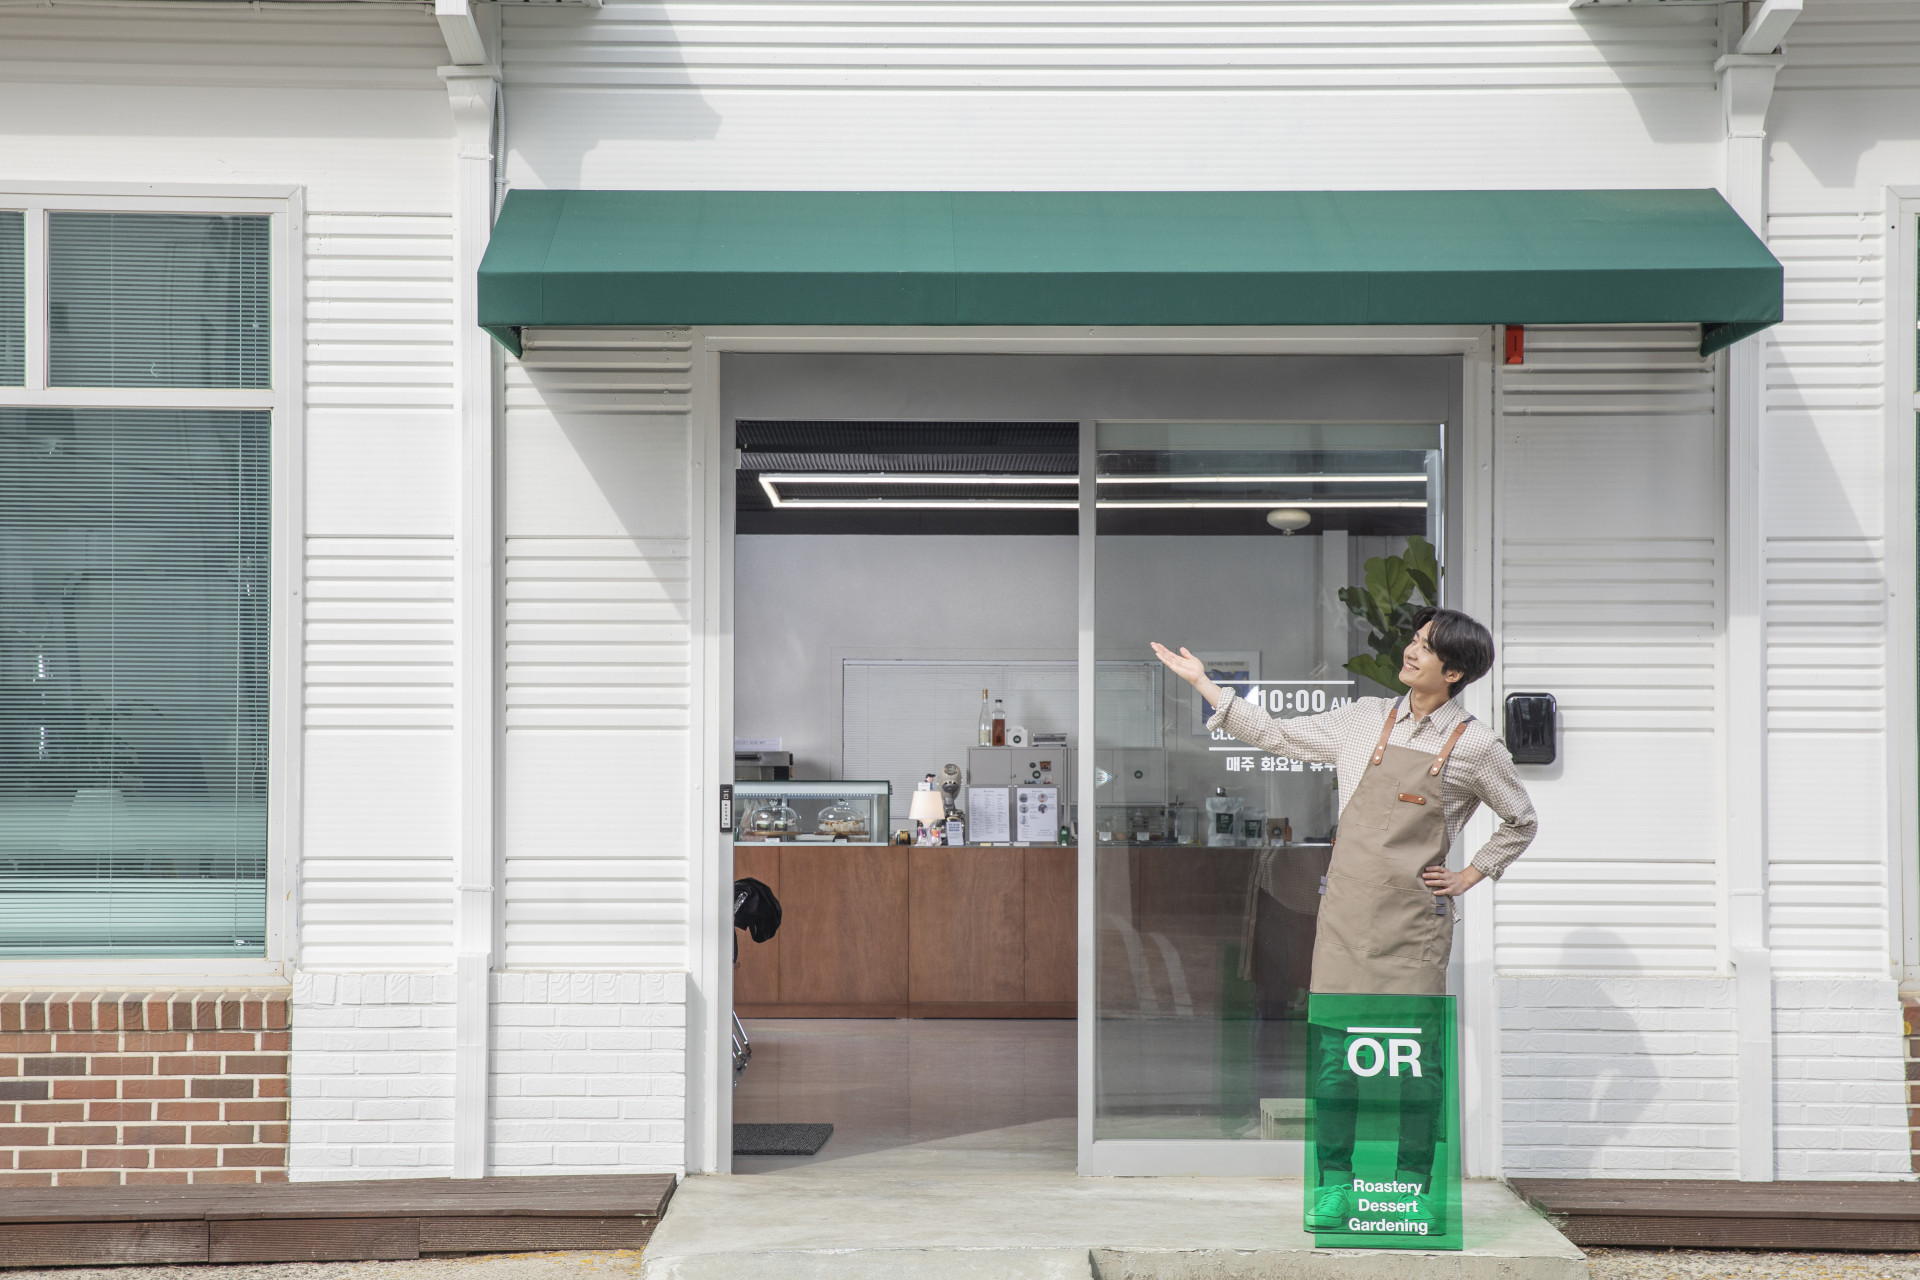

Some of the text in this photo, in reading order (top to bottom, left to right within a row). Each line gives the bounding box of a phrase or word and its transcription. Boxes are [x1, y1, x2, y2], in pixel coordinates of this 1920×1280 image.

[1259, 689, 1326, 712] 10:00
[1226, 756, 1255, 771] 매주
[1261, 756, 1303, 771] 화요일
[1347, 1037, 1422, 1077] OR
[1353, 1179, 1422, 1196] Roastery
[1358, 1198, 1418, 1212] Dessert
[1348, 1217, 1428, 1235] Gardening
